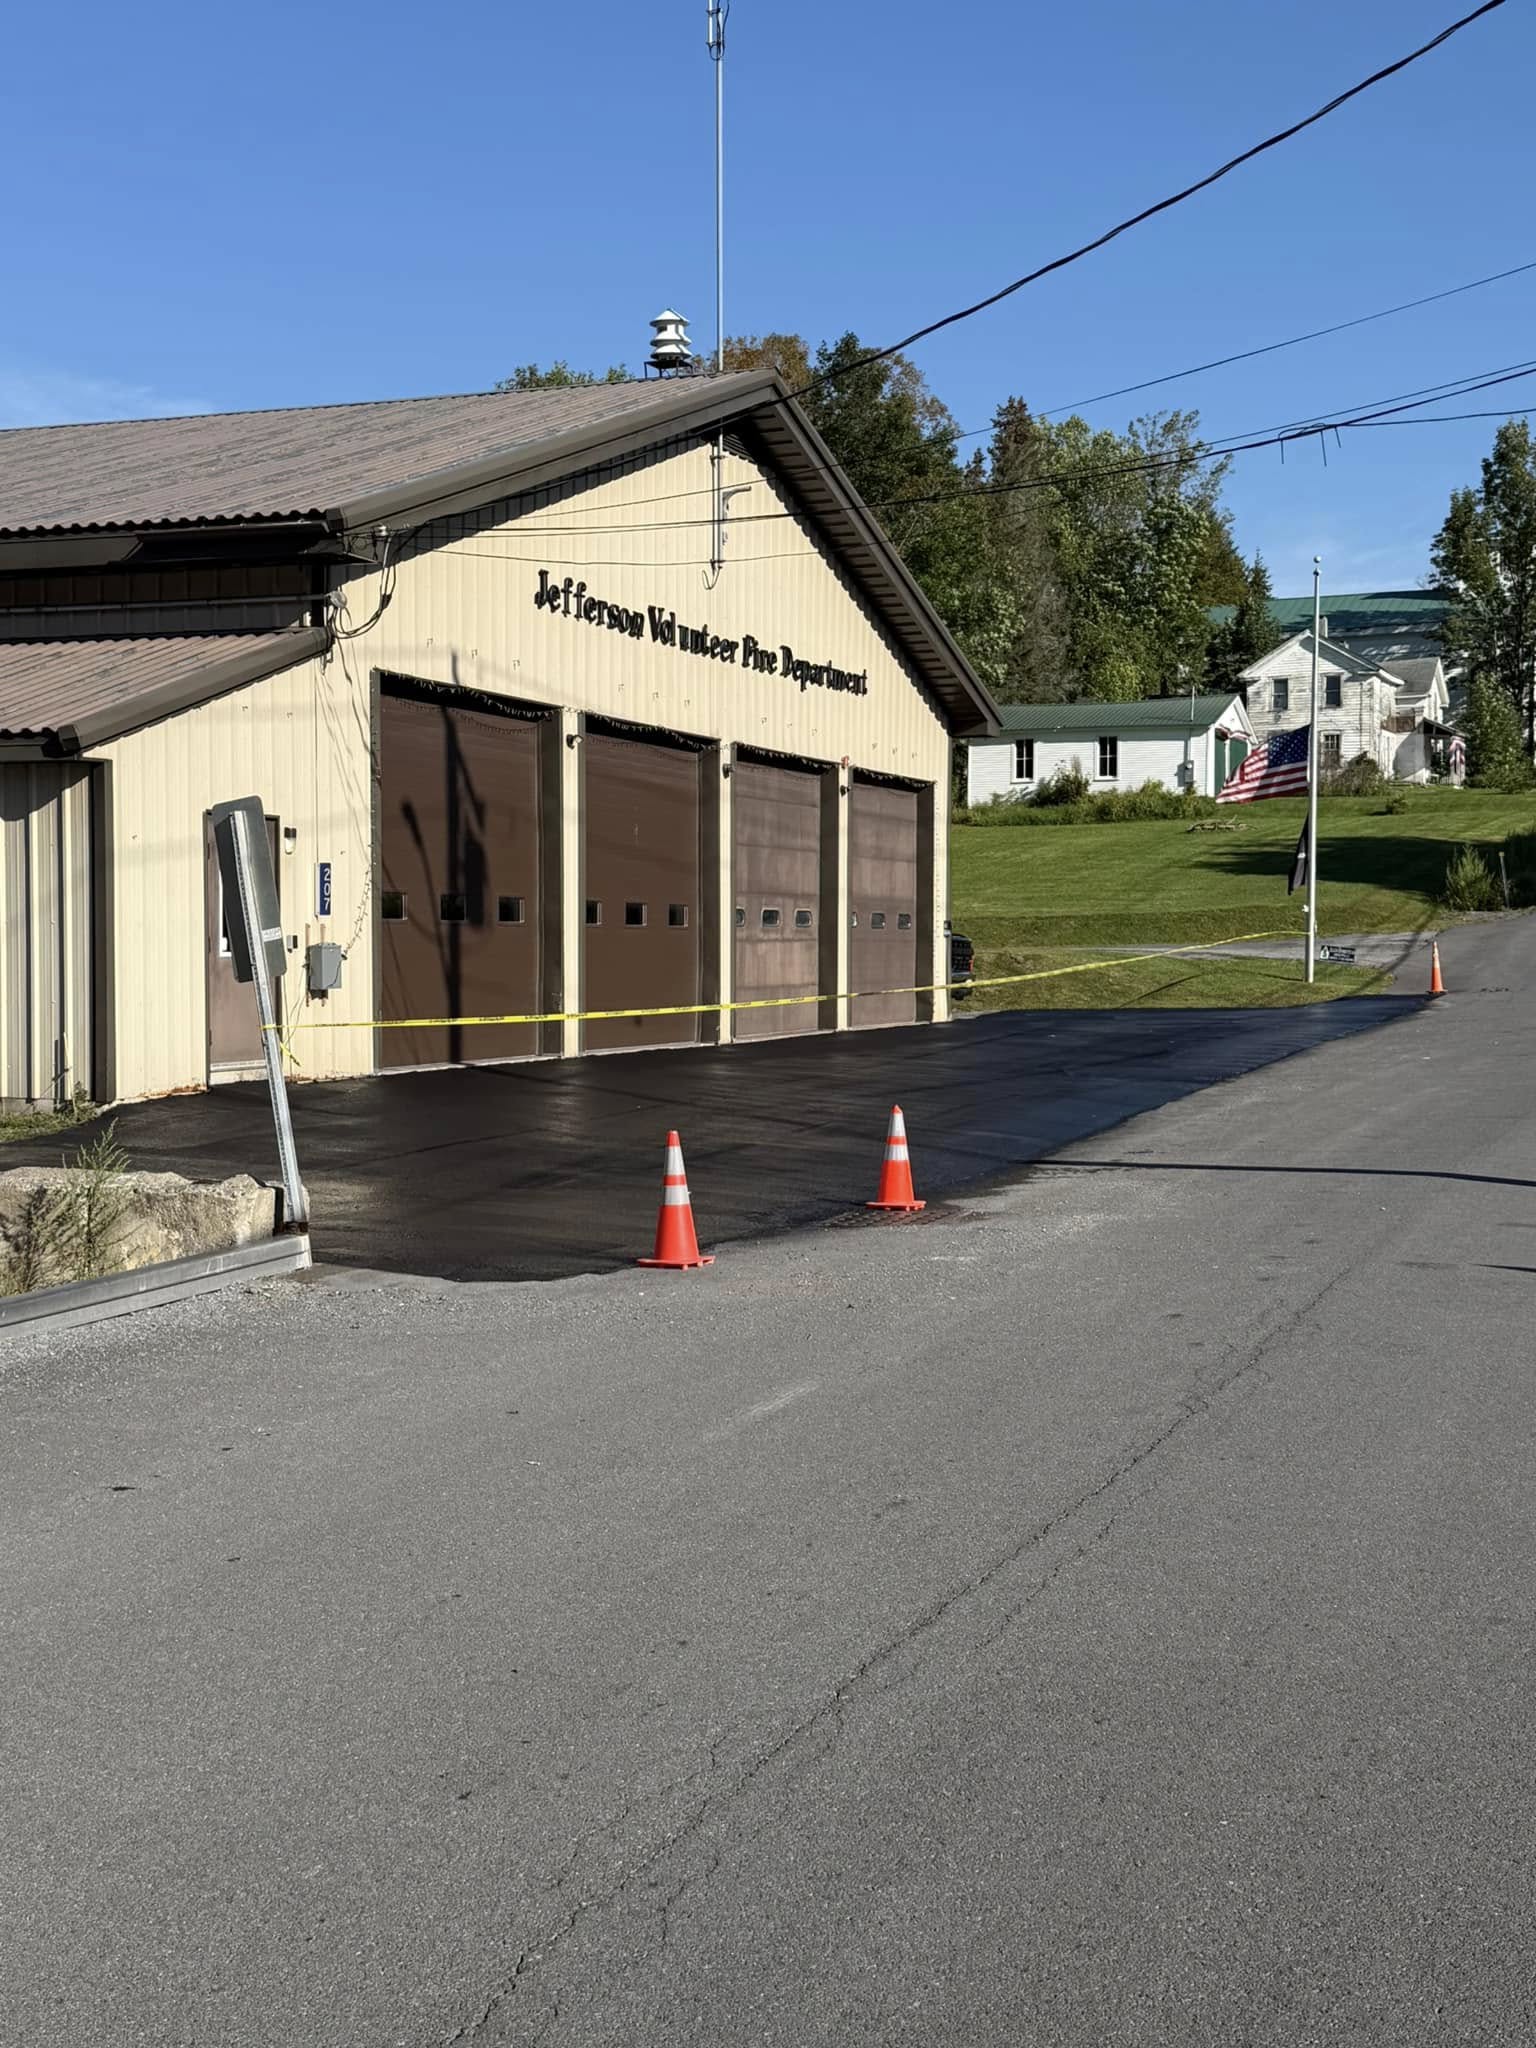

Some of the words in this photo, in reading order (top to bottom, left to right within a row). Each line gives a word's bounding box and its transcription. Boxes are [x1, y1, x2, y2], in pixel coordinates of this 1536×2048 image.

[534, 569, 645, 640] Jefferson
[647, 605, 738, 664] Volunteer
[741, 635, 777, 675] Fire
[779, 645, 868, 696] Department
[323, 867, 331, 911] 207
